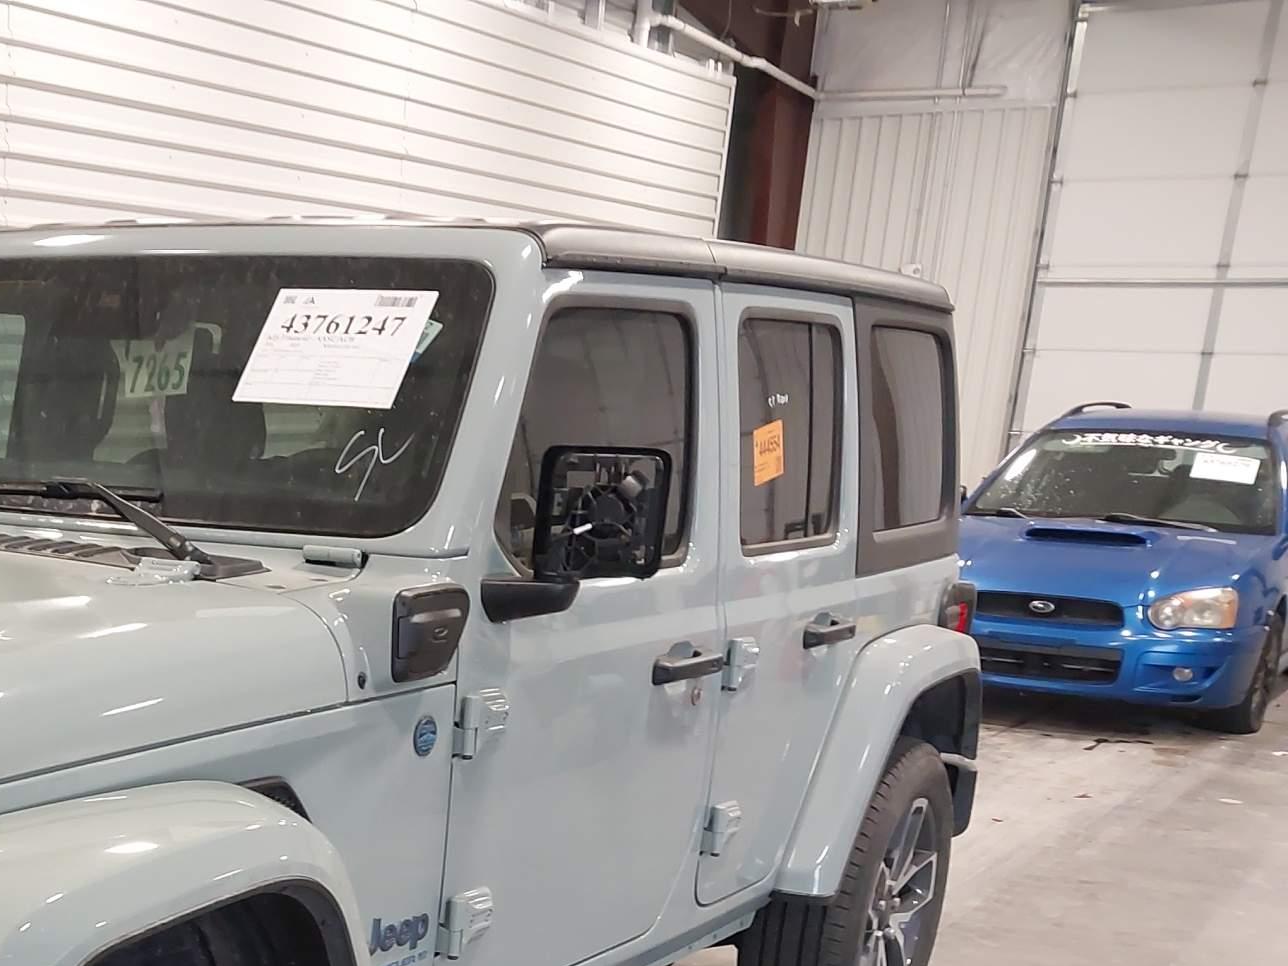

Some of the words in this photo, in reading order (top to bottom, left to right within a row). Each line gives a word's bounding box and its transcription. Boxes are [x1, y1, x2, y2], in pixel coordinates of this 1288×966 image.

[280, 313, 407, 337] 43761247
[129, 352, 188, 394] 7265
[368, 912, 430, 957] Jeep
